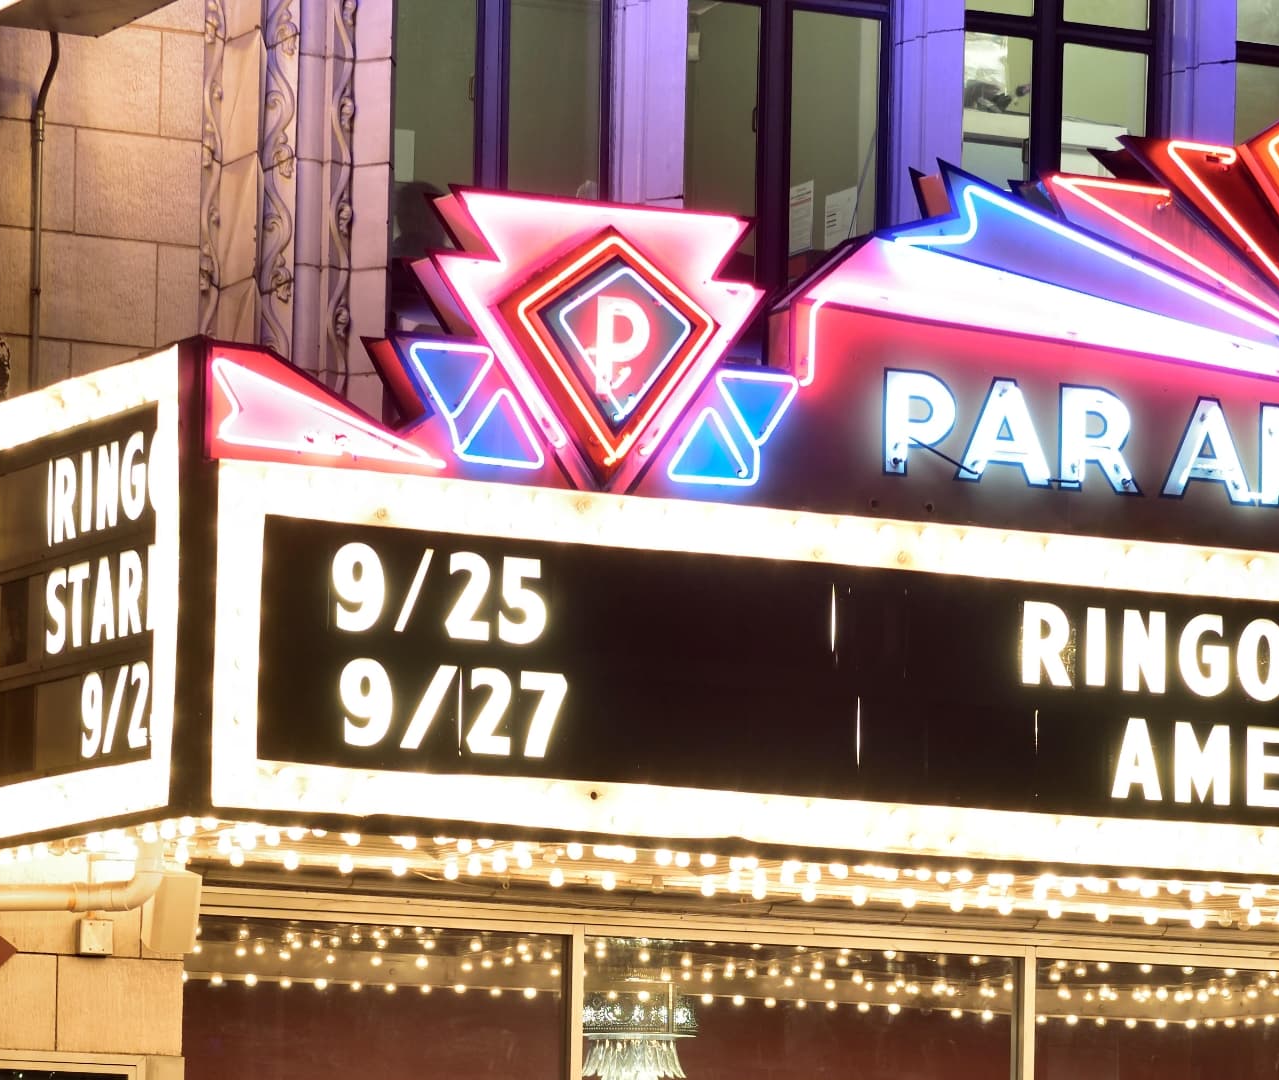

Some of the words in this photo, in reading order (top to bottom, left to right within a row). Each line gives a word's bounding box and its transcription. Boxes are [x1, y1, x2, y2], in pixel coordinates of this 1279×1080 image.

[332, 543, 547, 644] 9/25
[81, 661, 152, 759] 9/2
[339, 657, 568, 758] 9/27
